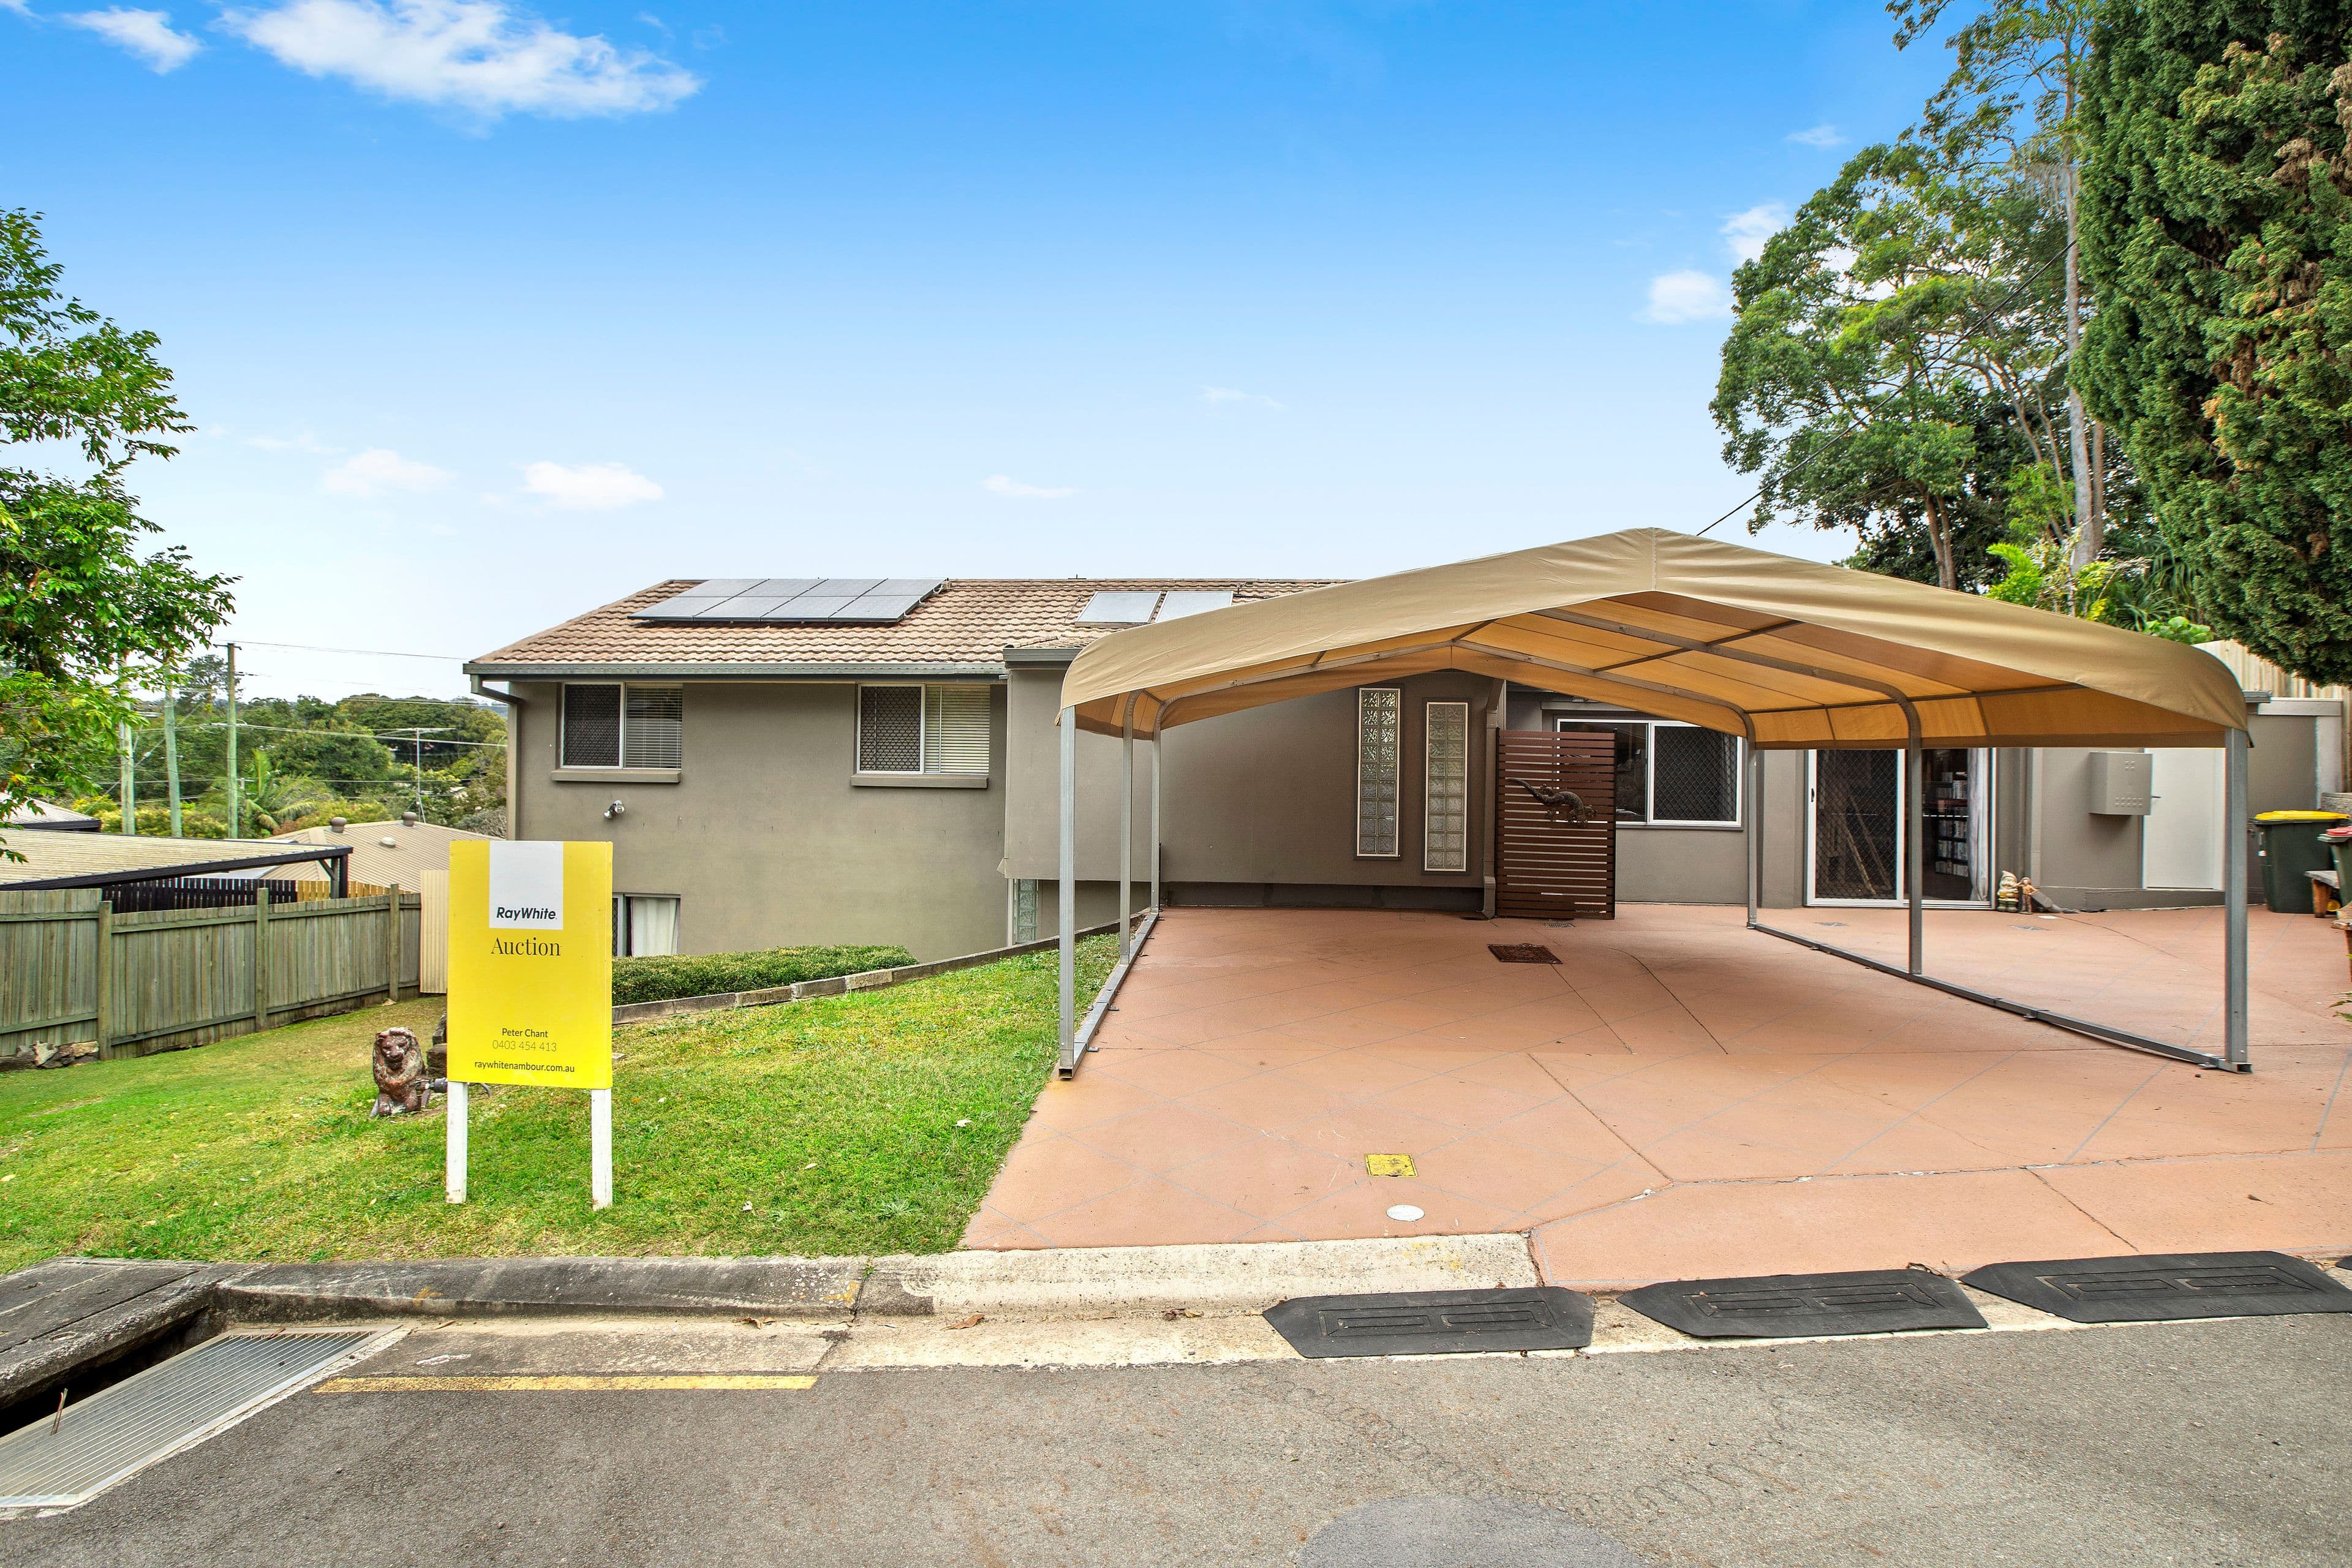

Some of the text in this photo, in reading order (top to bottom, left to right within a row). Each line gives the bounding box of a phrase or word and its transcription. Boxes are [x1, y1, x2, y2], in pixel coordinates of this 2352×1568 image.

[496, 907, 556, 921] RayWhite
[491, 937, 561, 956] Auction
[502, 1028, 548, 1038] Peter Chant
[492, 1039, 557, 1052] 0403 454 413
[475, 1060, 575, 1072] raywhitenambour.com.au
